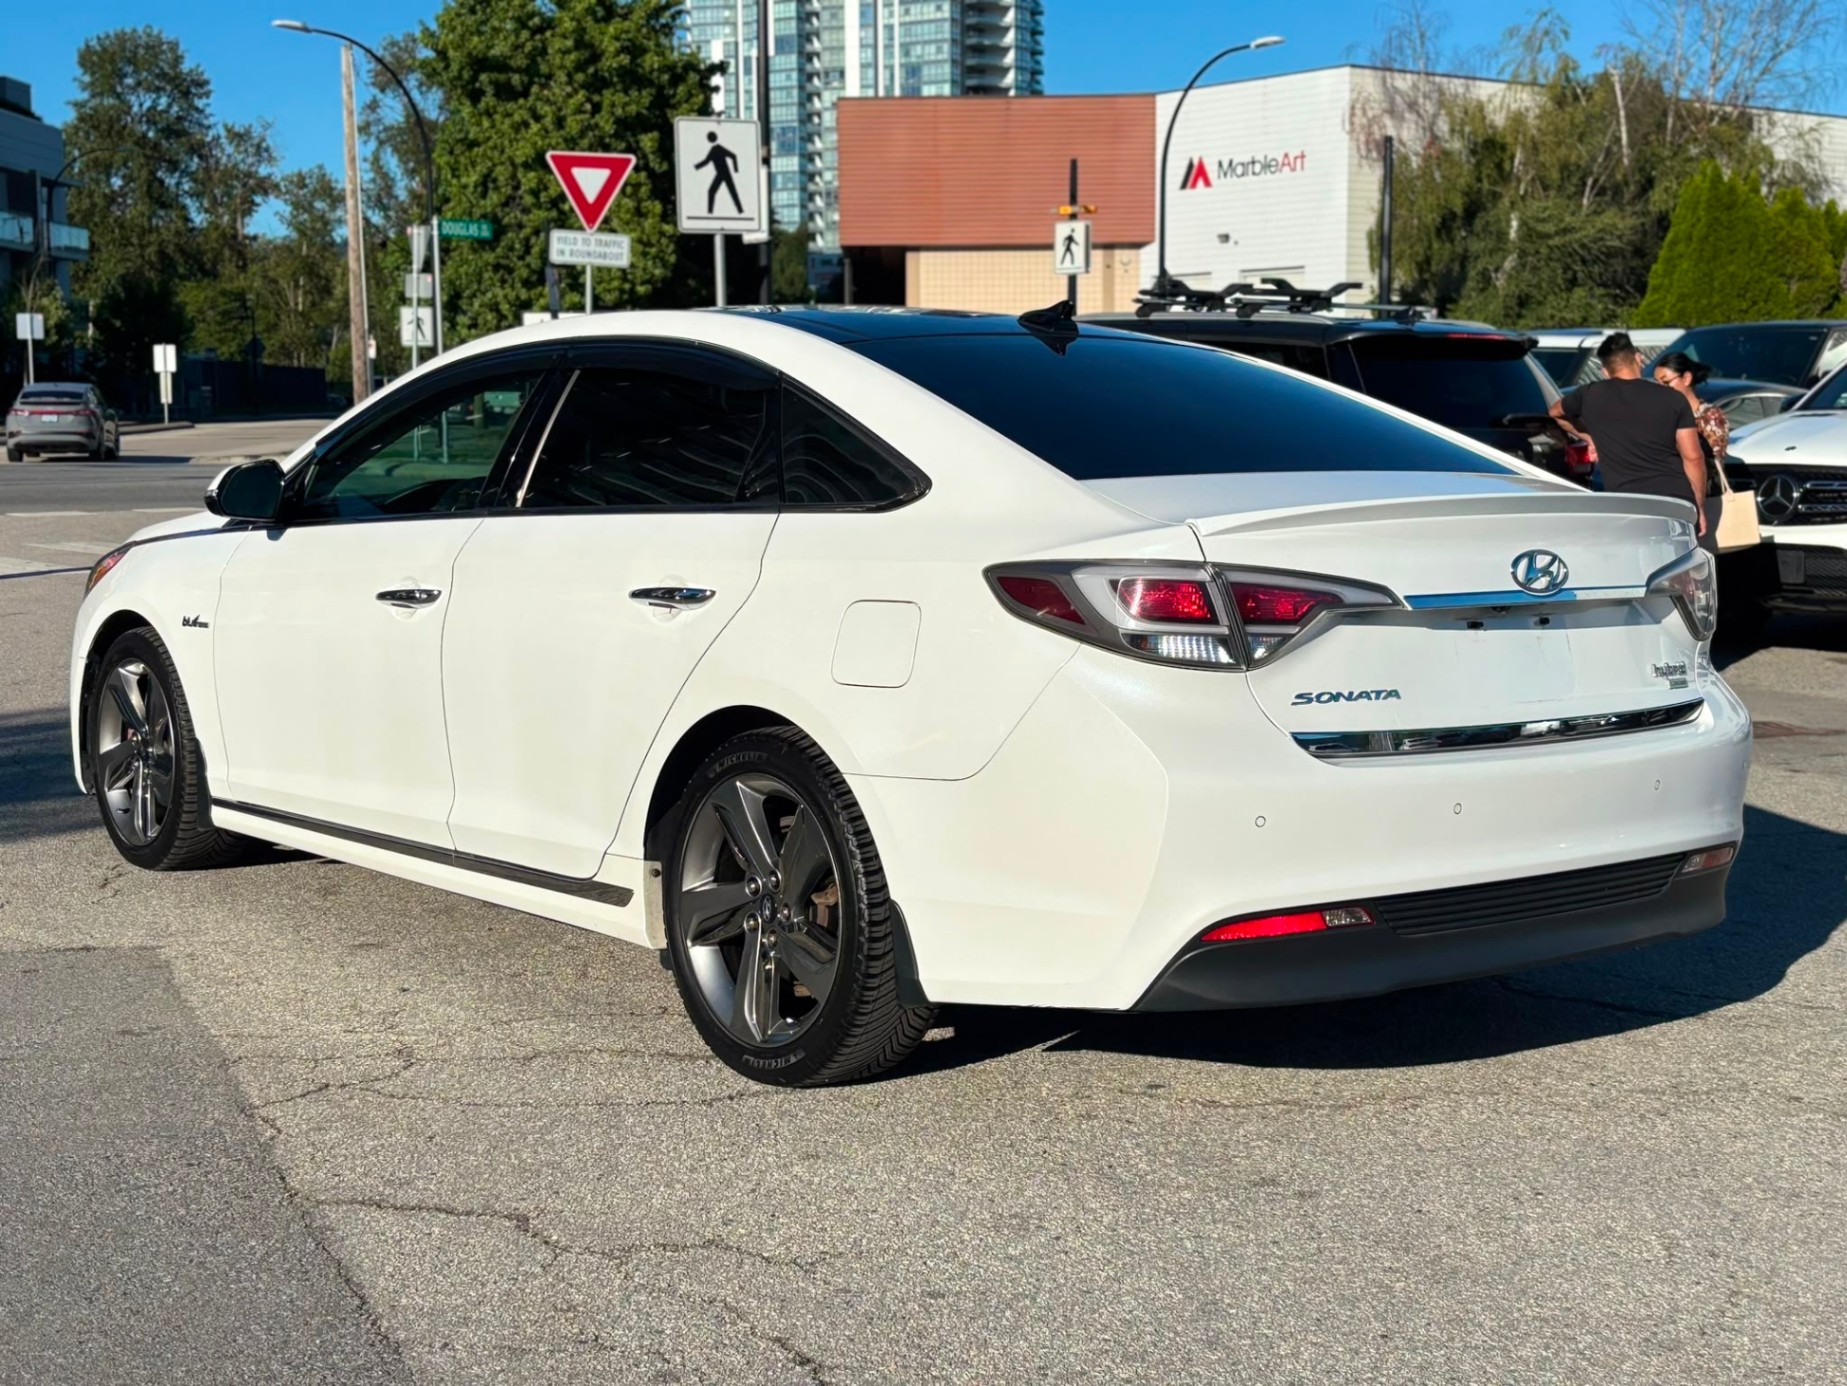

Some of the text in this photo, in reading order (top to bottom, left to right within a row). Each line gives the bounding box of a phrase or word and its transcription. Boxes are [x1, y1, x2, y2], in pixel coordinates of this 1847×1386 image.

[1217, 150, 1307, 180] MarbleArt
[441, 221, 479, 237] DOUGLAS
[556, 236, 626, 250] YIELD TO TRAFFIC
[556, 248, 625, 261] IN ROUNDABOUT
[1291, 689, 1402, 706] SONATA
